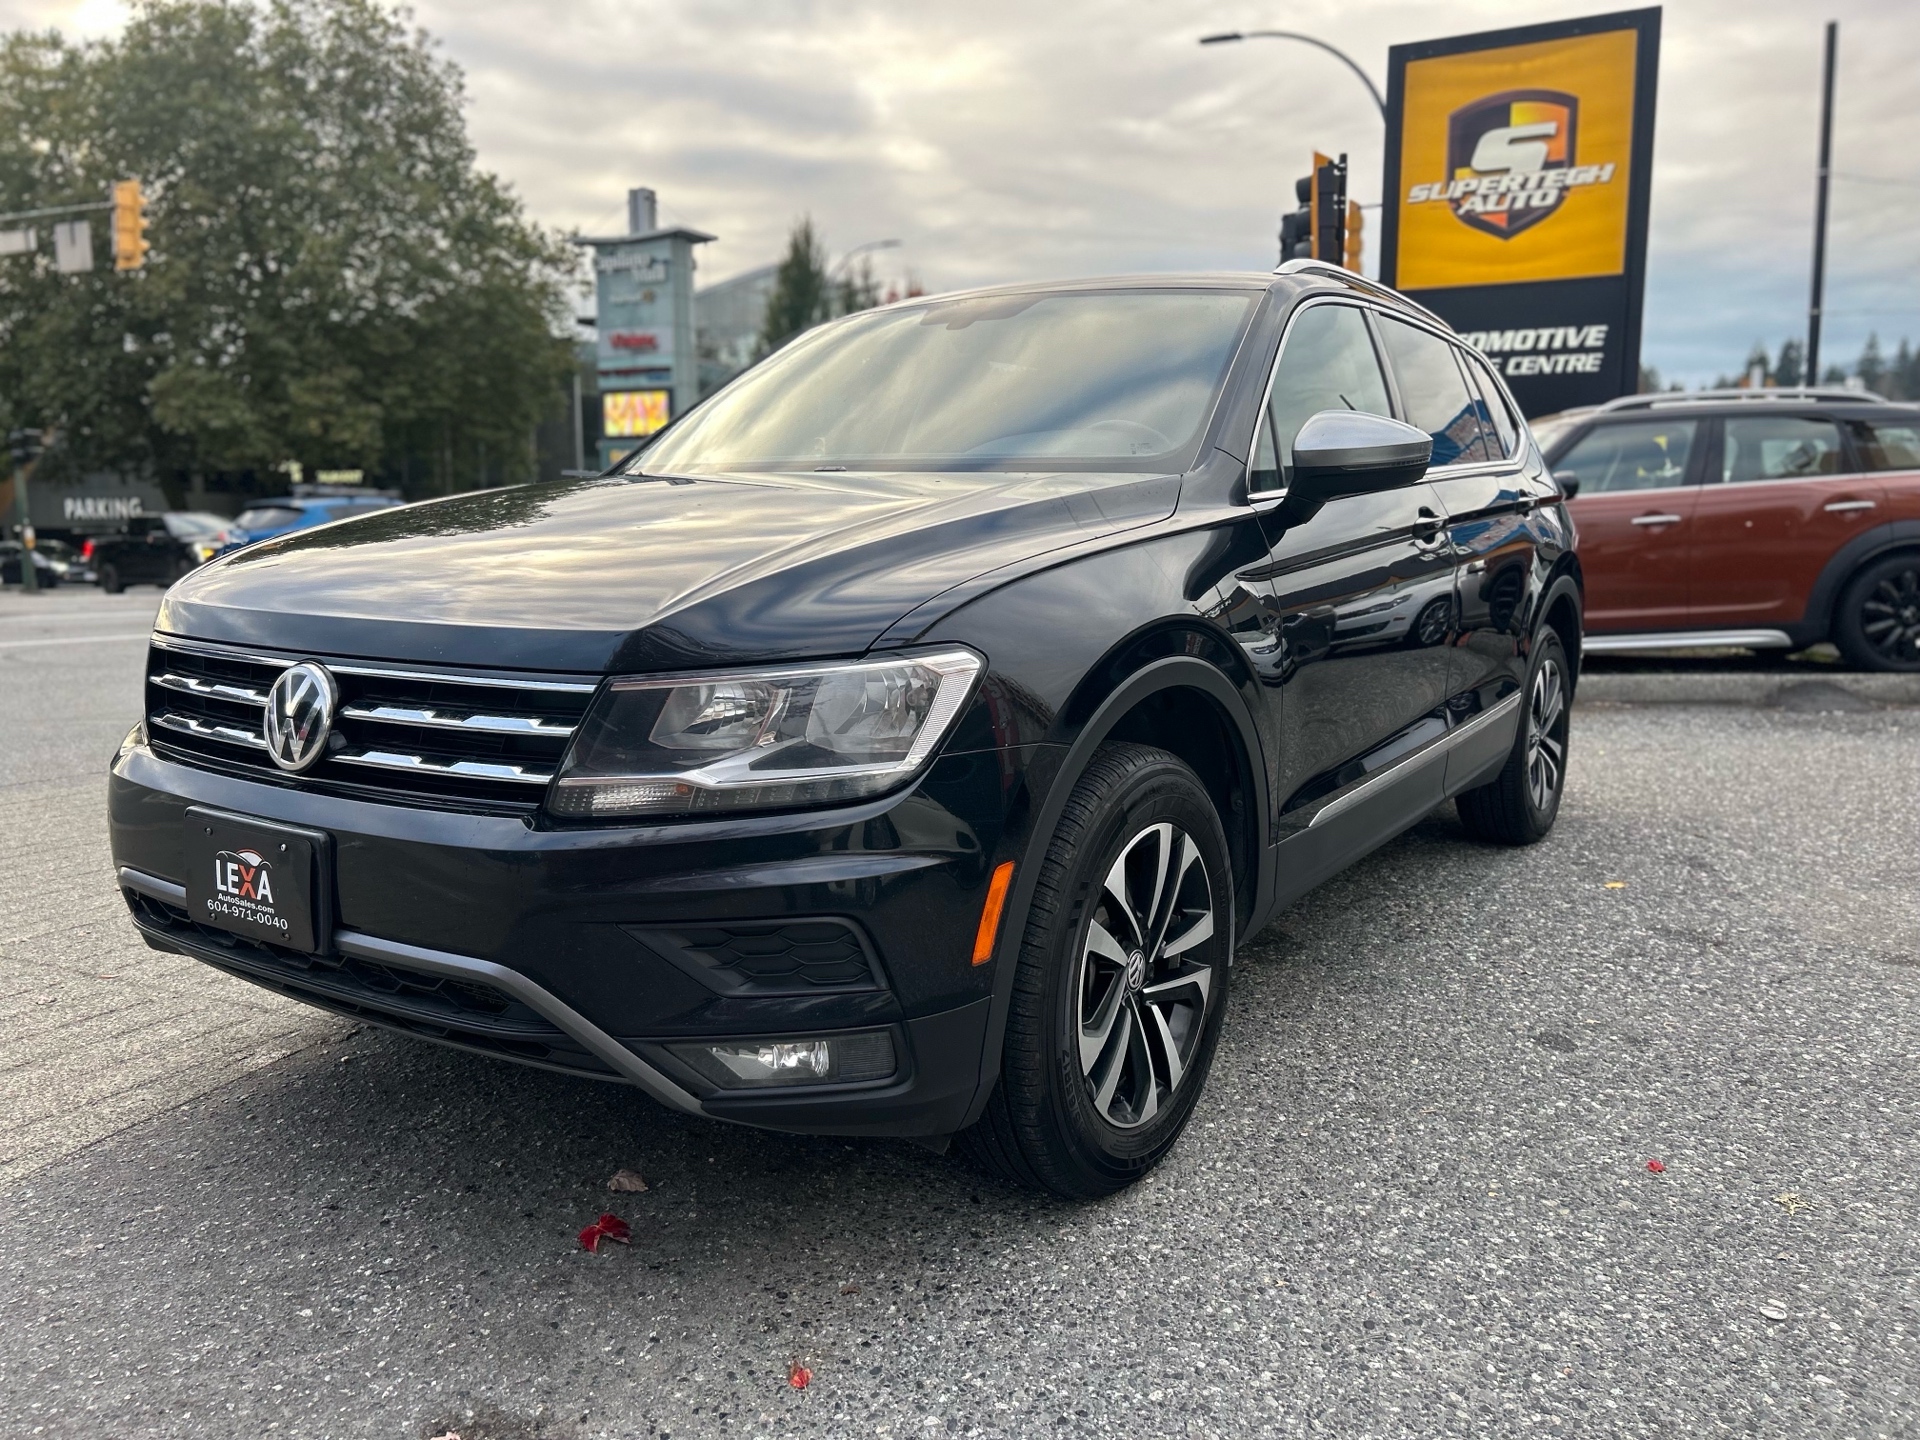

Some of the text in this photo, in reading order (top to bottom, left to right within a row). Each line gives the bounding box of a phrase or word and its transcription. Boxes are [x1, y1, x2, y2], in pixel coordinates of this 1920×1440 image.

[1458, 188, 1561, 215] AUTO
[1505, 352, 1604, 376] CENTRE
[64, 496, 143, 520] PARKING
[215, 859, 274, 904] LEXA
[207, 899, 288, 930] 604-971-0040
[217, 892, 275, 914] AutoSales.com
